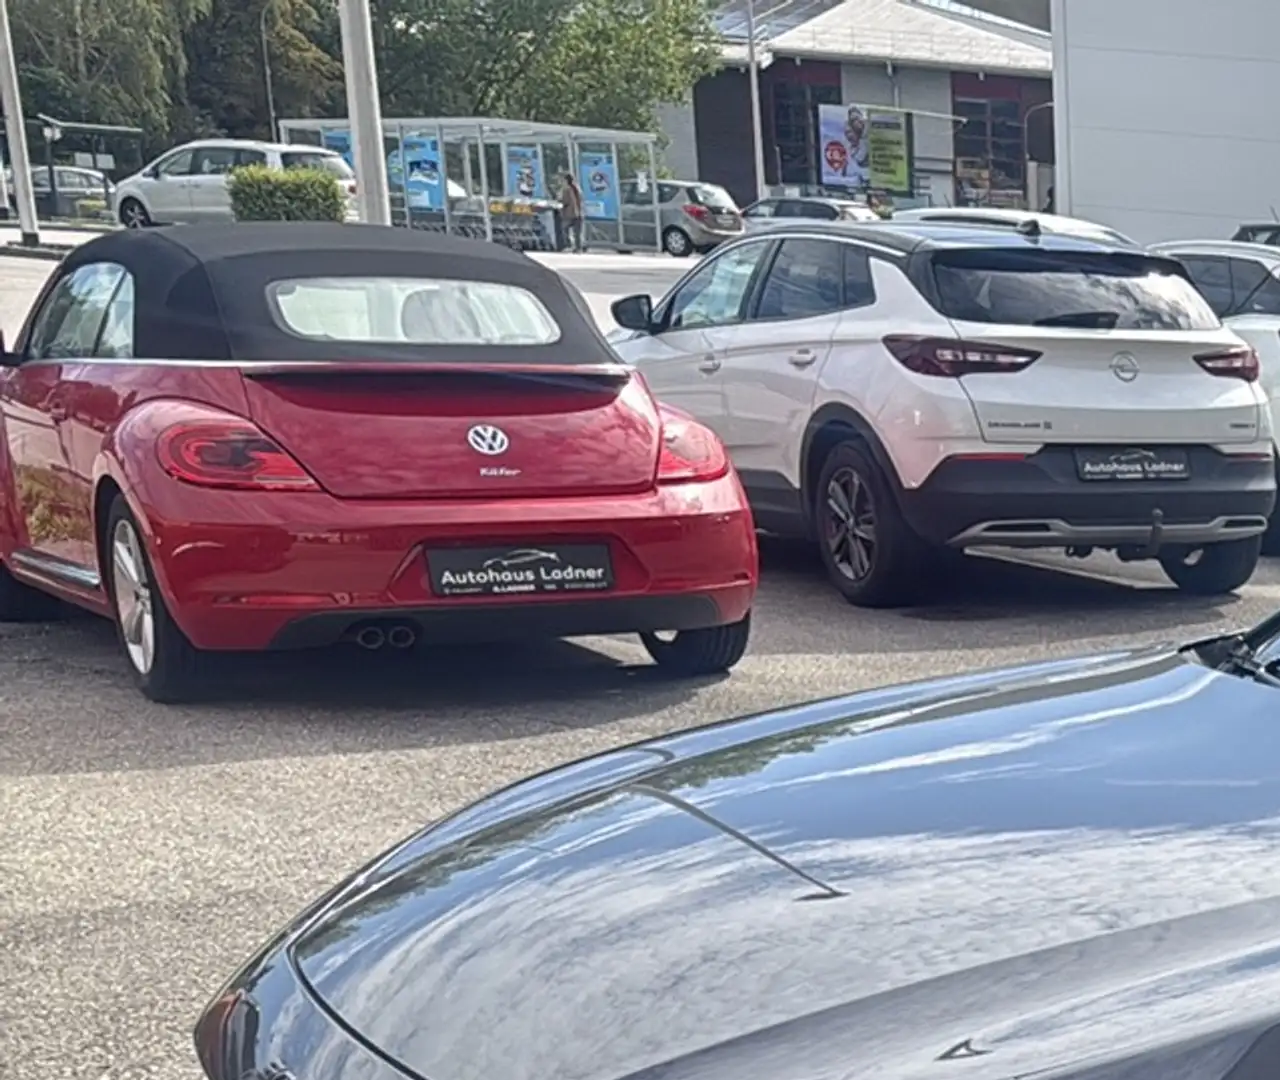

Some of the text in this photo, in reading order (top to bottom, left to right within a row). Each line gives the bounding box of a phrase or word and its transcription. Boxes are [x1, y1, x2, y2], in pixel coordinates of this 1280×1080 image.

[1083, 460, 1185, 473] Autohaus Ladner
[441, 565, 605, 585] Autohaus Ladner
